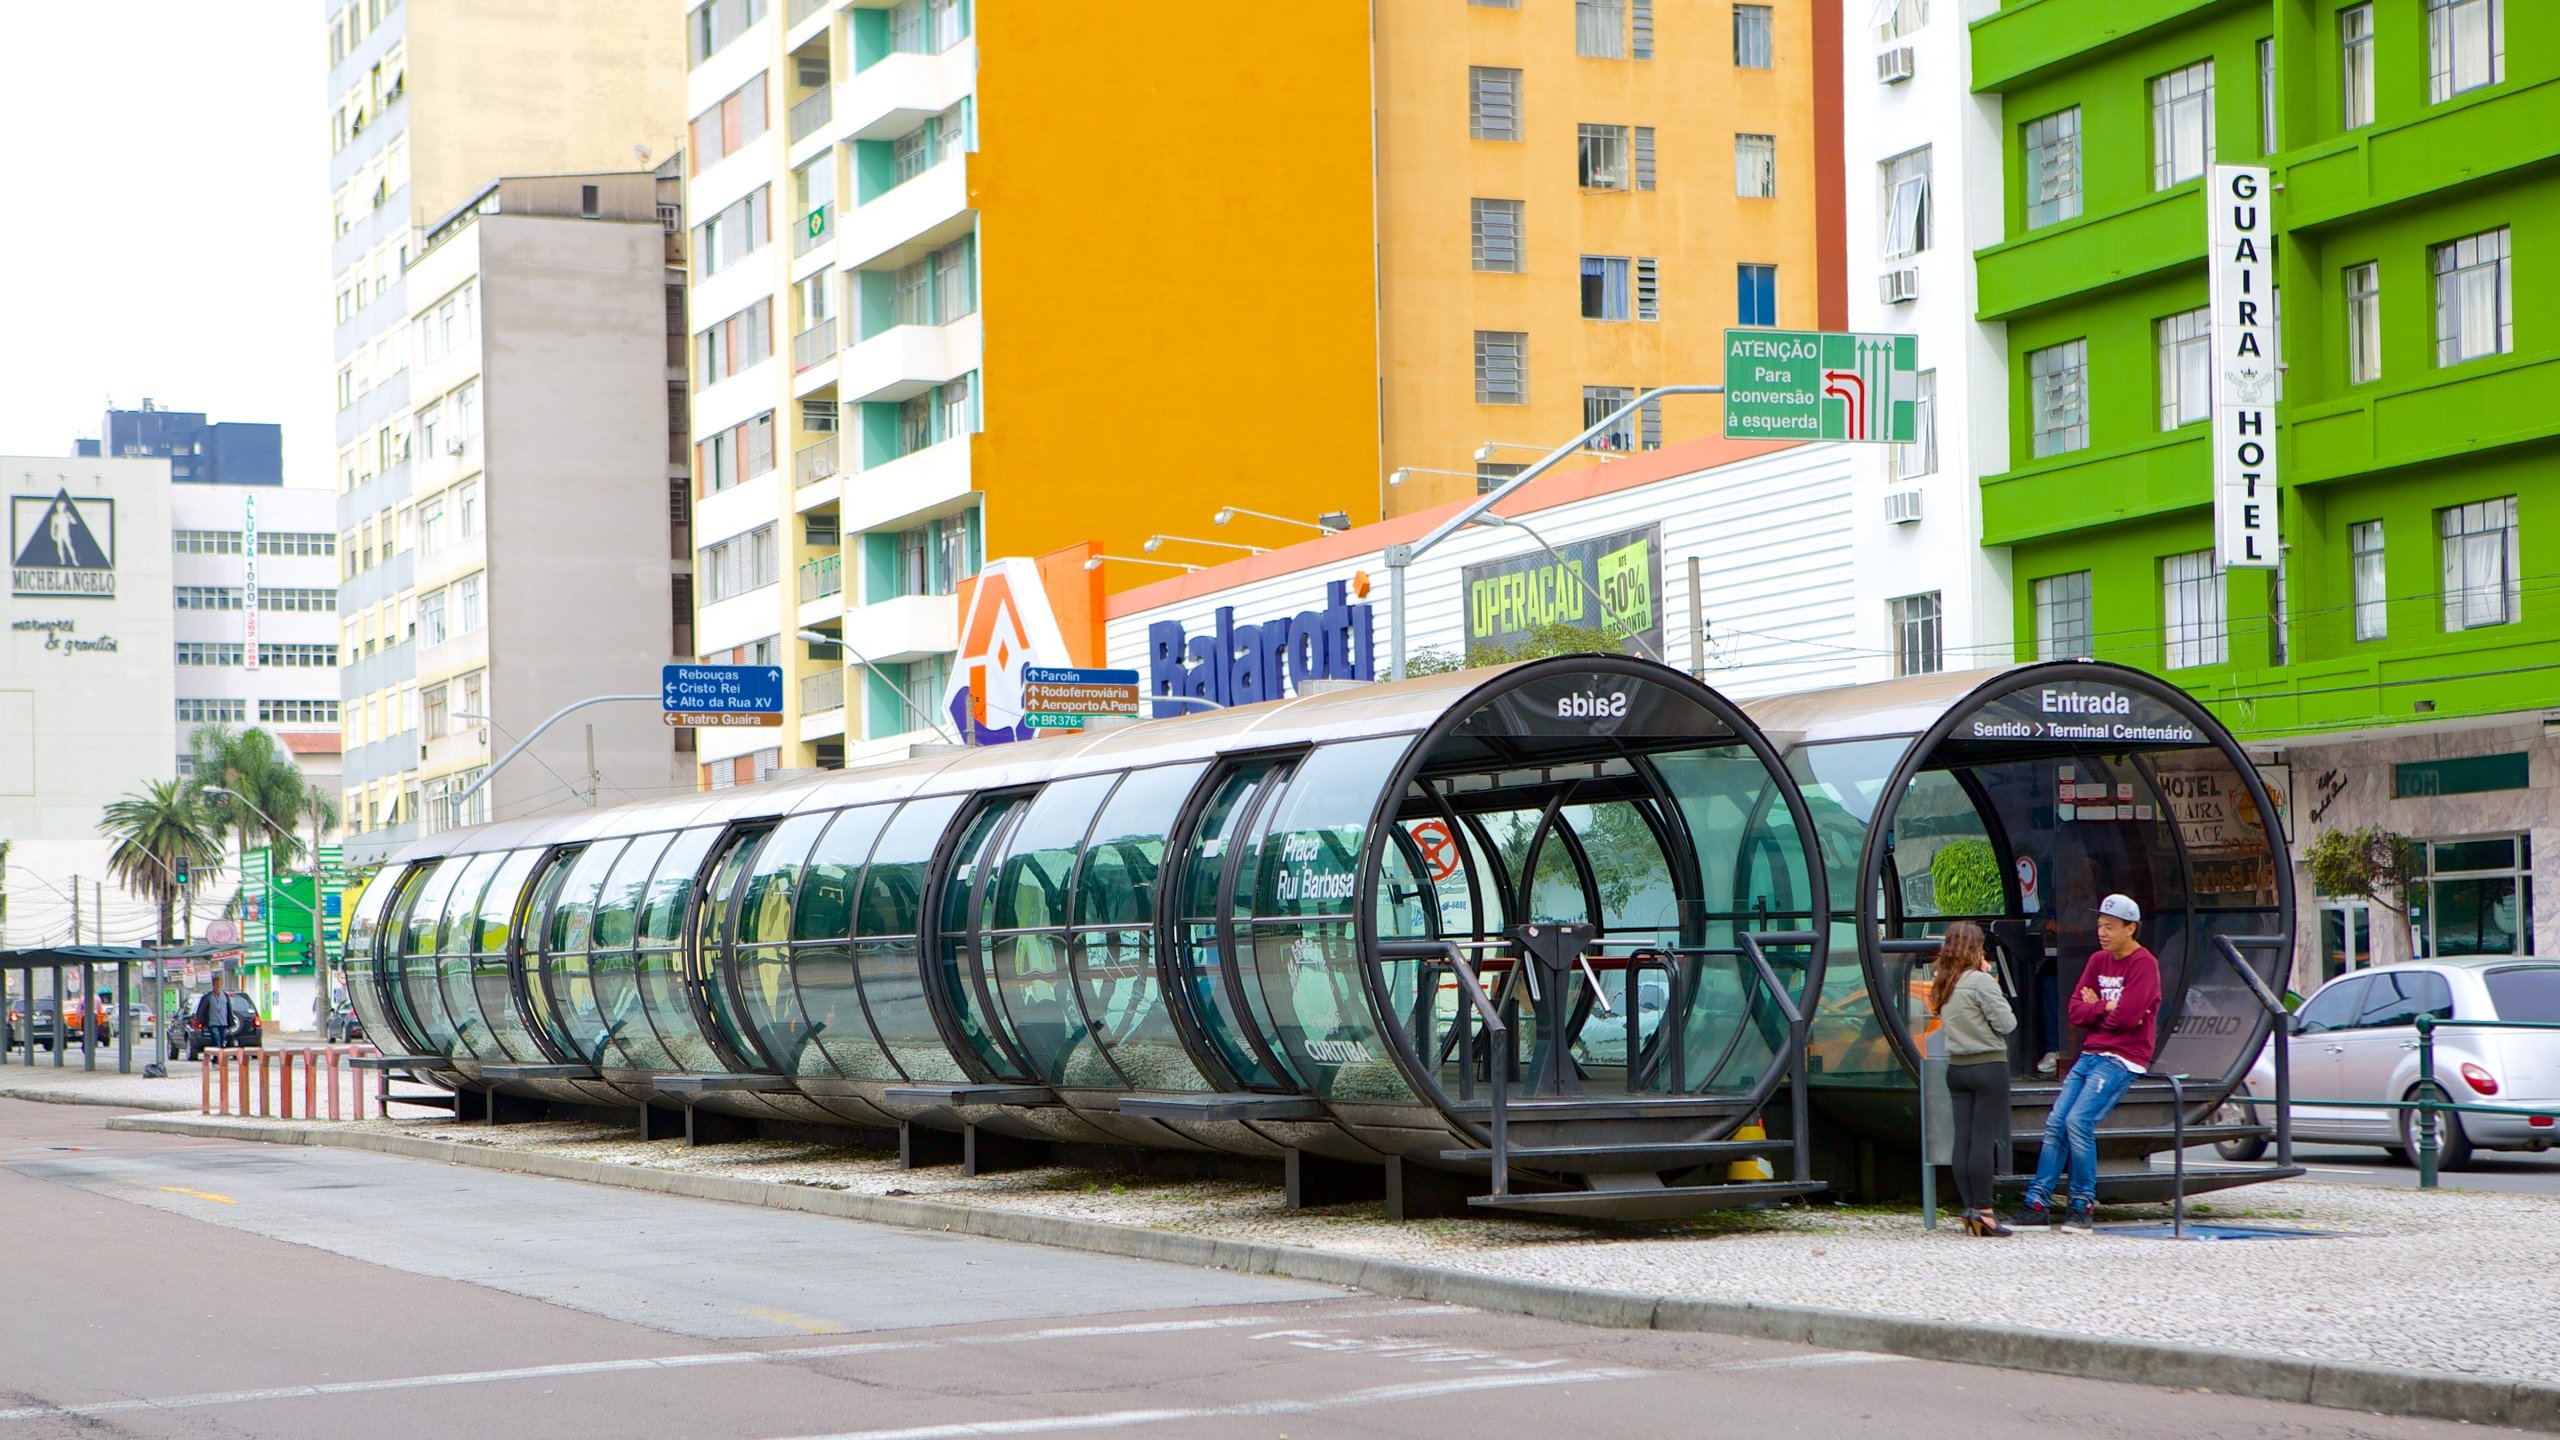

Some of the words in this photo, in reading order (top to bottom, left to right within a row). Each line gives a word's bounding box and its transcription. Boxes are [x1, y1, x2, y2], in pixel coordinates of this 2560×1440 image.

[2231, 174, 2261, 358] GUAIRA
[1730, 339, 1817, 362] ATENÇÃO
[1754, 367, 1791, 383] Para
[1731, 390, 1814, 405] conversão
[1728, 412, 1738, 427] à
[1742, 412, 1818, 431] esquerda
[2237, 410, 2264, 561] HOTEL
[246, 494, 255, 558] ALUGA
[1618, 553, 1627, 568] ATÉ
[12, 570, 116, 593] MICHELANGELO
[1603, 564, 1645, 619] 50%
[1149, 572, 1373, 720] Balaroti
[679, 669, 739, 682] Rebouças
[1040, 670, 1080, 682] Parolin
[679, 683, 716, 693] Cristo
[721, 683, 741, 693] Rei
[1041, 686, 1129, 699] Rodoferroviária
[680, 697, 704, 707] Alto
[709, 697, 724, 707] da
[728, 697, 751, 708] Rua
[755, 697, 772, 708] XV
[1041, 699, 1099, 712] Aeroporto
[2042, 689, 2130, 714] Entrada
[680, 713, 718, 724] Teatro
[1973, 722, 2031, 737] Sentido
[2047, 723, 2109, 739] Terminal
[2112, 724, 2193, 741] Centenário
[2160, 775, 2221, 798] HOTEL
[2162, 825, 2223, 842] PLACE
[1281, 833, 1319, 870] Praça
[1277, 870, 1298, 900] Rui
[1301, 871, 1354, 900] Barbosa
[1304, 1040, 1373, 1063] CURITIBA
